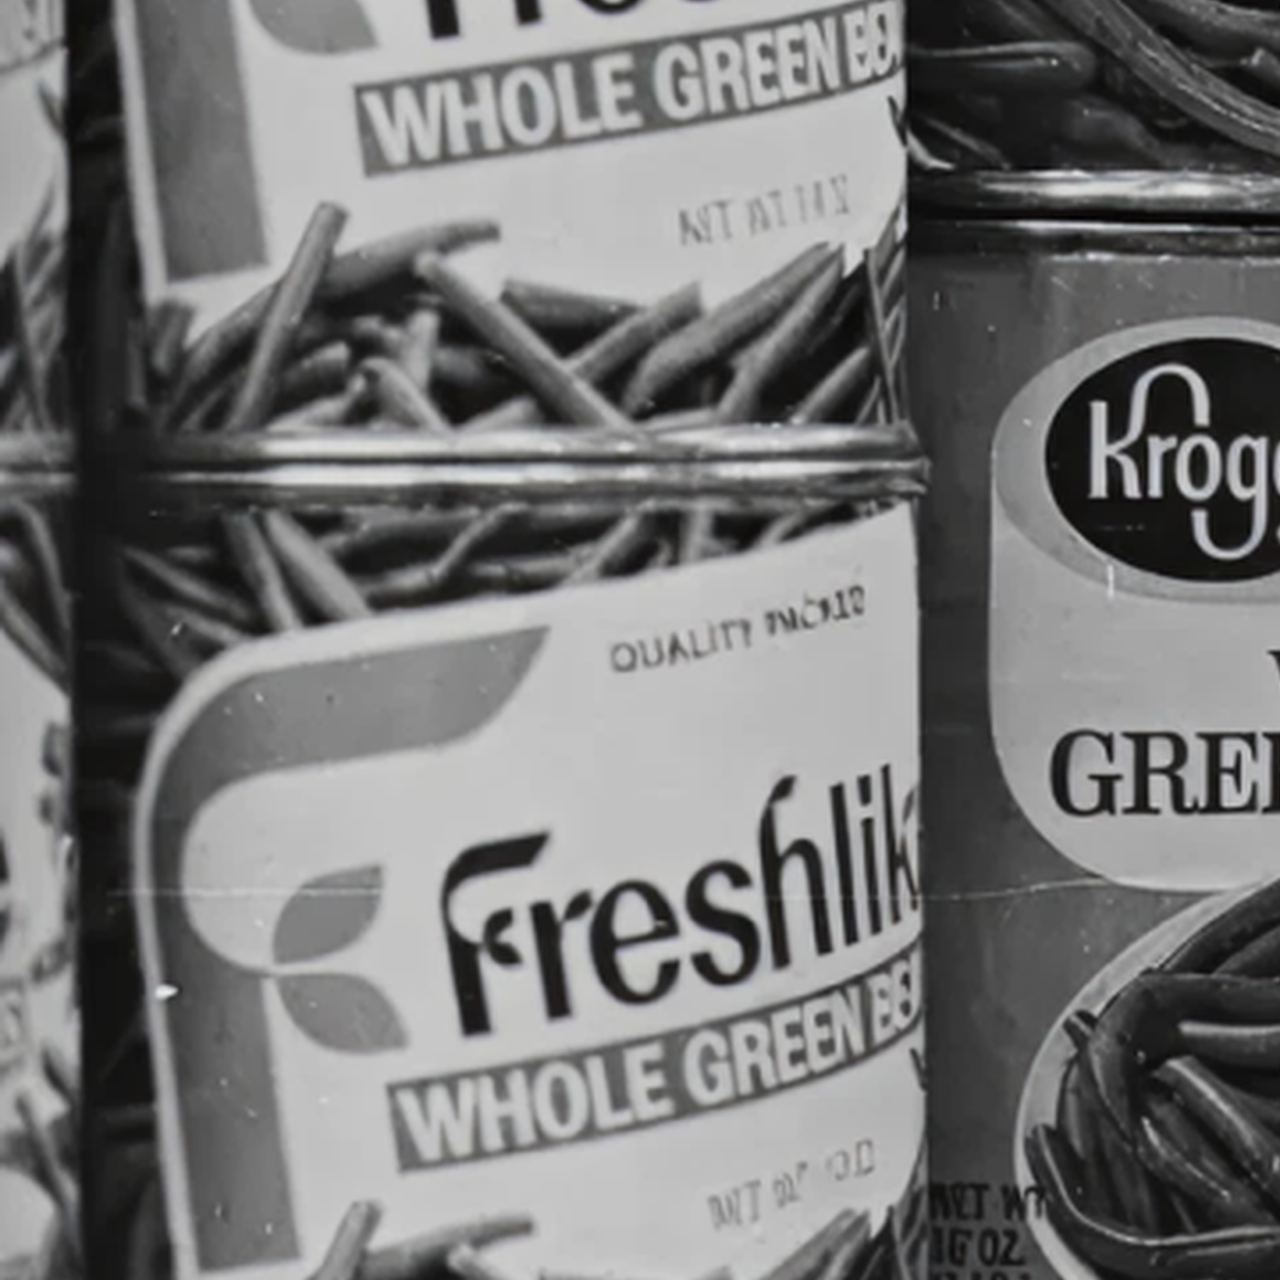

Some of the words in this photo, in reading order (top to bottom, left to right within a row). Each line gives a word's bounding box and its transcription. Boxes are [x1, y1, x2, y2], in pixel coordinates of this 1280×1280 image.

[361, 52, 643, 166] WHOLE
[652, 16, 841, 122] GREEN
[440, 764, 919, 1038] Freshlik
[398, 1042, 673, 1163] WHOLE
[683, 984, 864, 1109] GREEN
